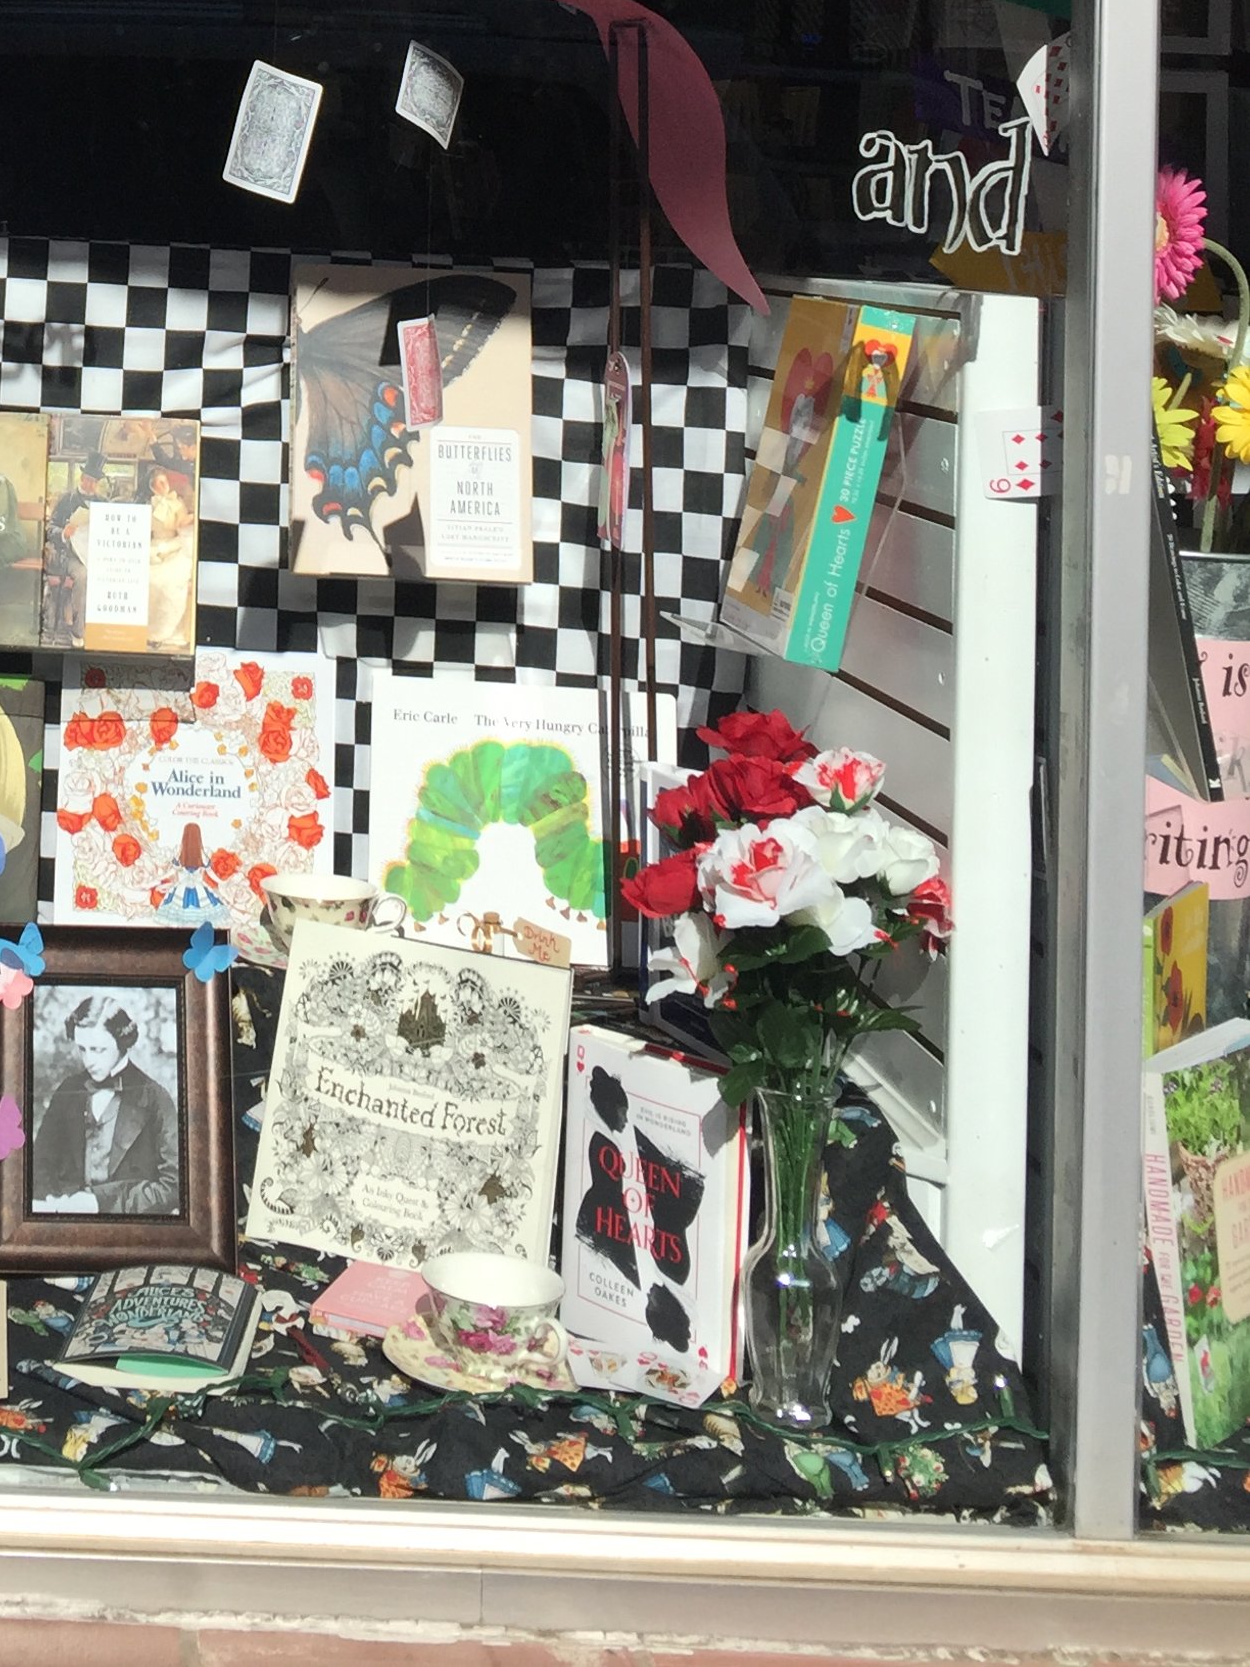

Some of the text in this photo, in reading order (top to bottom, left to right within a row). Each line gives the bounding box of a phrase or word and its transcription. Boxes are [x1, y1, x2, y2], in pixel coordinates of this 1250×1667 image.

[852, 116, 1032, 256] and
[437, 444, 512, 462] BUTTERFLIES
[456, 480, 494, 496] NORTH
[989, 478, 1012, 494] 6
[450, 499, 501, 516] AMERICA
[105, 514, 137, 523] HOW TO
[111, 527, 120, 535] BE
[96, 539, 143, 550] VICTORIAN
[827, 527, 852, 578] Hearts
[107, 591, 129, 601] RUTH
[823, 580, 840, 599] of
[96, 605, 138, 614] GOODMAN
[809, 601, 835, 654] Queen
[392, 708, 585, 736] Eric Carle The Very Hungry
[167, 768, 225, 785] Alice in
[151, 781, 242, 799] Wonderland
[523, 924, 561, 954] Drink
[528, 941, 551, 963] Me
[315, 1065, 508, 1137] Enchanted Forest
[645, 1116, 692, 1137] WONDERLAND
[663, 1113, 688, 1127] RISING
[598, 1144, 683, 1200] QUEEN
[361, 1183, 375, 1194] An
[621, 1186, 658, 1219] OF
[402, 1207, 424, 1221] Book
[593, 1205, 684, 1265] HEARTS
[588, 1271, 636, 1298] COLLEEN
[109, 1296, 208, 1316] ADVENTURES
[593, 1286, 629, 1309] OAKES
